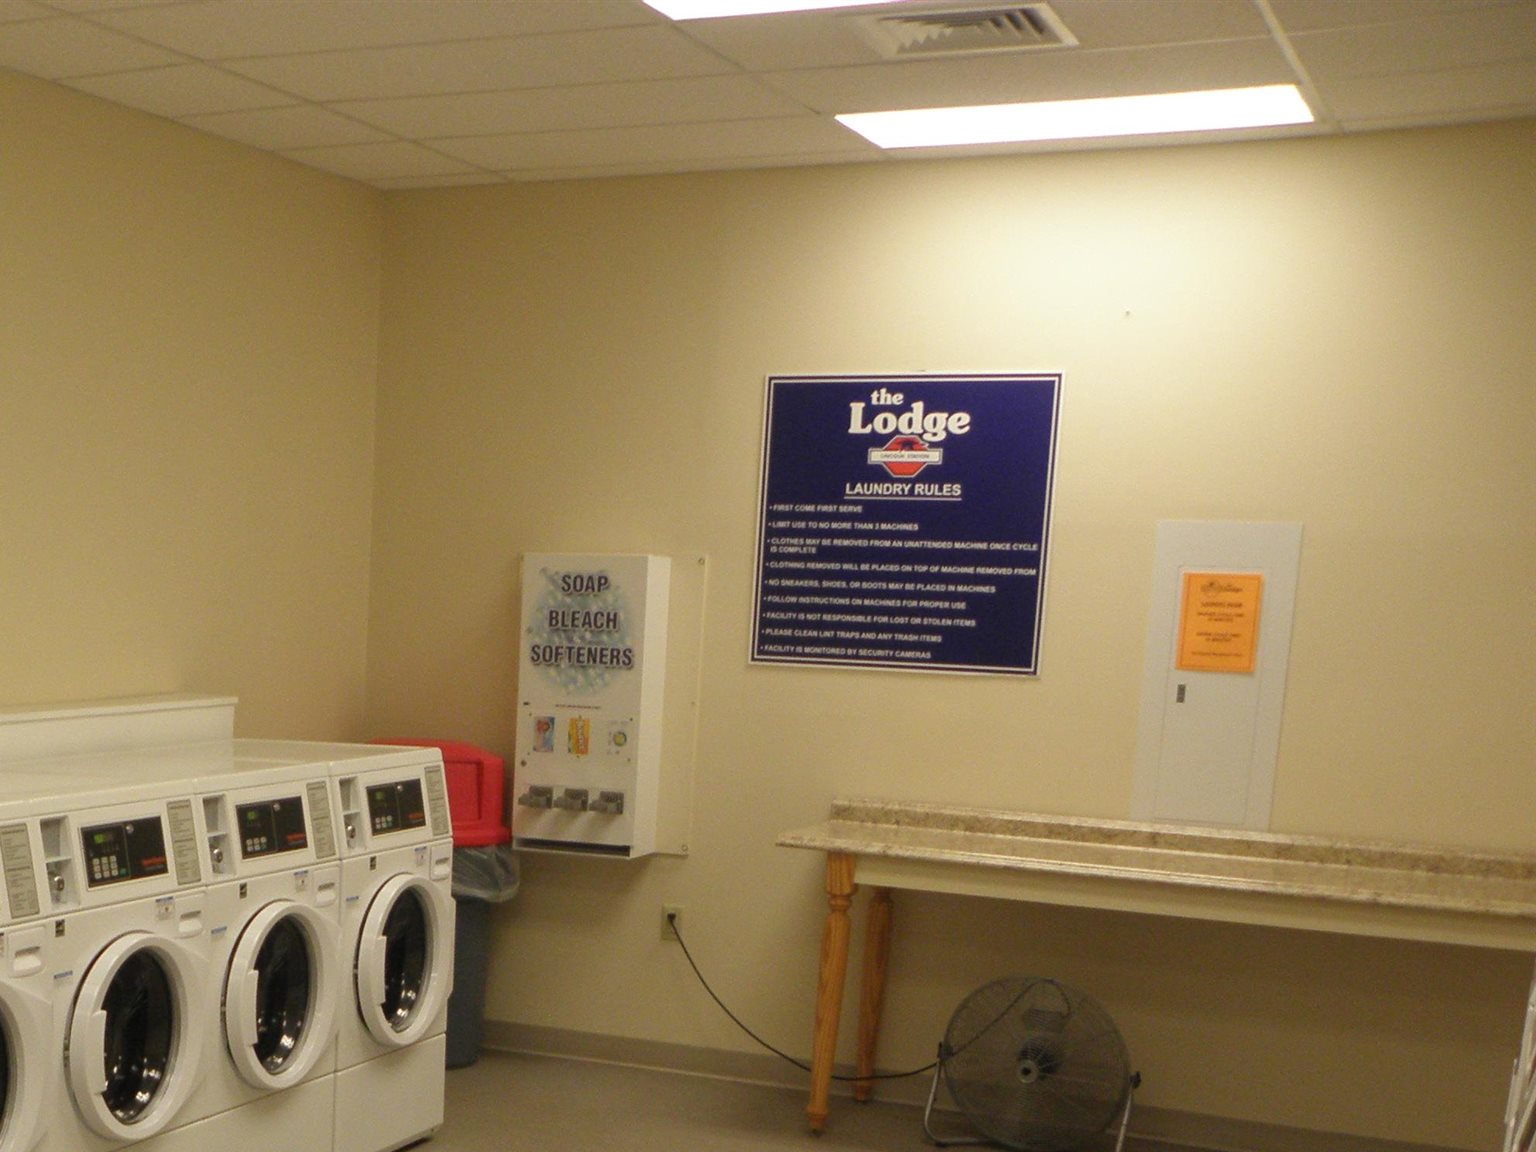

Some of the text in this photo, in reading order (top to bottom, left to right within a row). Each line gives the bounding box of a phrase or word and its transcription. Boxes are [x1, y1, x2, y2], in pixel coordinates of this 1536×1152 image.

[871, 388, 903, 405] the
[848, 401, 970, 442] Lodge
[846, 482, 962, 496] LAUNDRY RULES
[881, 523, 918, 531] MACHINES
[779, 546, 816, 554] COMPLETE
[905, 541, 952, 549] UNATTENDED
[1012, 543, 1038, 551] CYCLE
[770, 561, 804, 569] CLOTHING
[807, 562, 840, 570] REMOVED
[941, 566, 974, 574] MACHINE
[976, 567, 1012, 575] REMOVED
[1014, 568, 1036, 576] FROM
[561, 574, 609, 594] SOAP
[917, 583, 946, 591] PLACED
[957, 585, 995, 593] MACHINES
[768, 595, 796, 603] FOLLOW
[799, 596, 849, 605] INSTRUCTIONS
[864, 598, 900, 606] MACHINES
[548, 610, 618, 630] BLEACH
[822, 614, 871, 622] RESPONSIBLE
[890, 616, 908, 624] LOST
[923, 618, 951, 626] STOLEN
[953, 619, 976, 627] ITEMS
[766, 628, 792, 636] PLEASE
[794, 629, 817, 637] CLEAN
[894, 633, 918, 641] TRASH
[920, 634, 942, 642] ITEMS
[531, 645, 633, 667] SOFTENERS
[804, 647, 845, 655] MONITORED
[858, 648, 894, 657] SECURITY
[895, 650, 931, 659] CAMERAS
